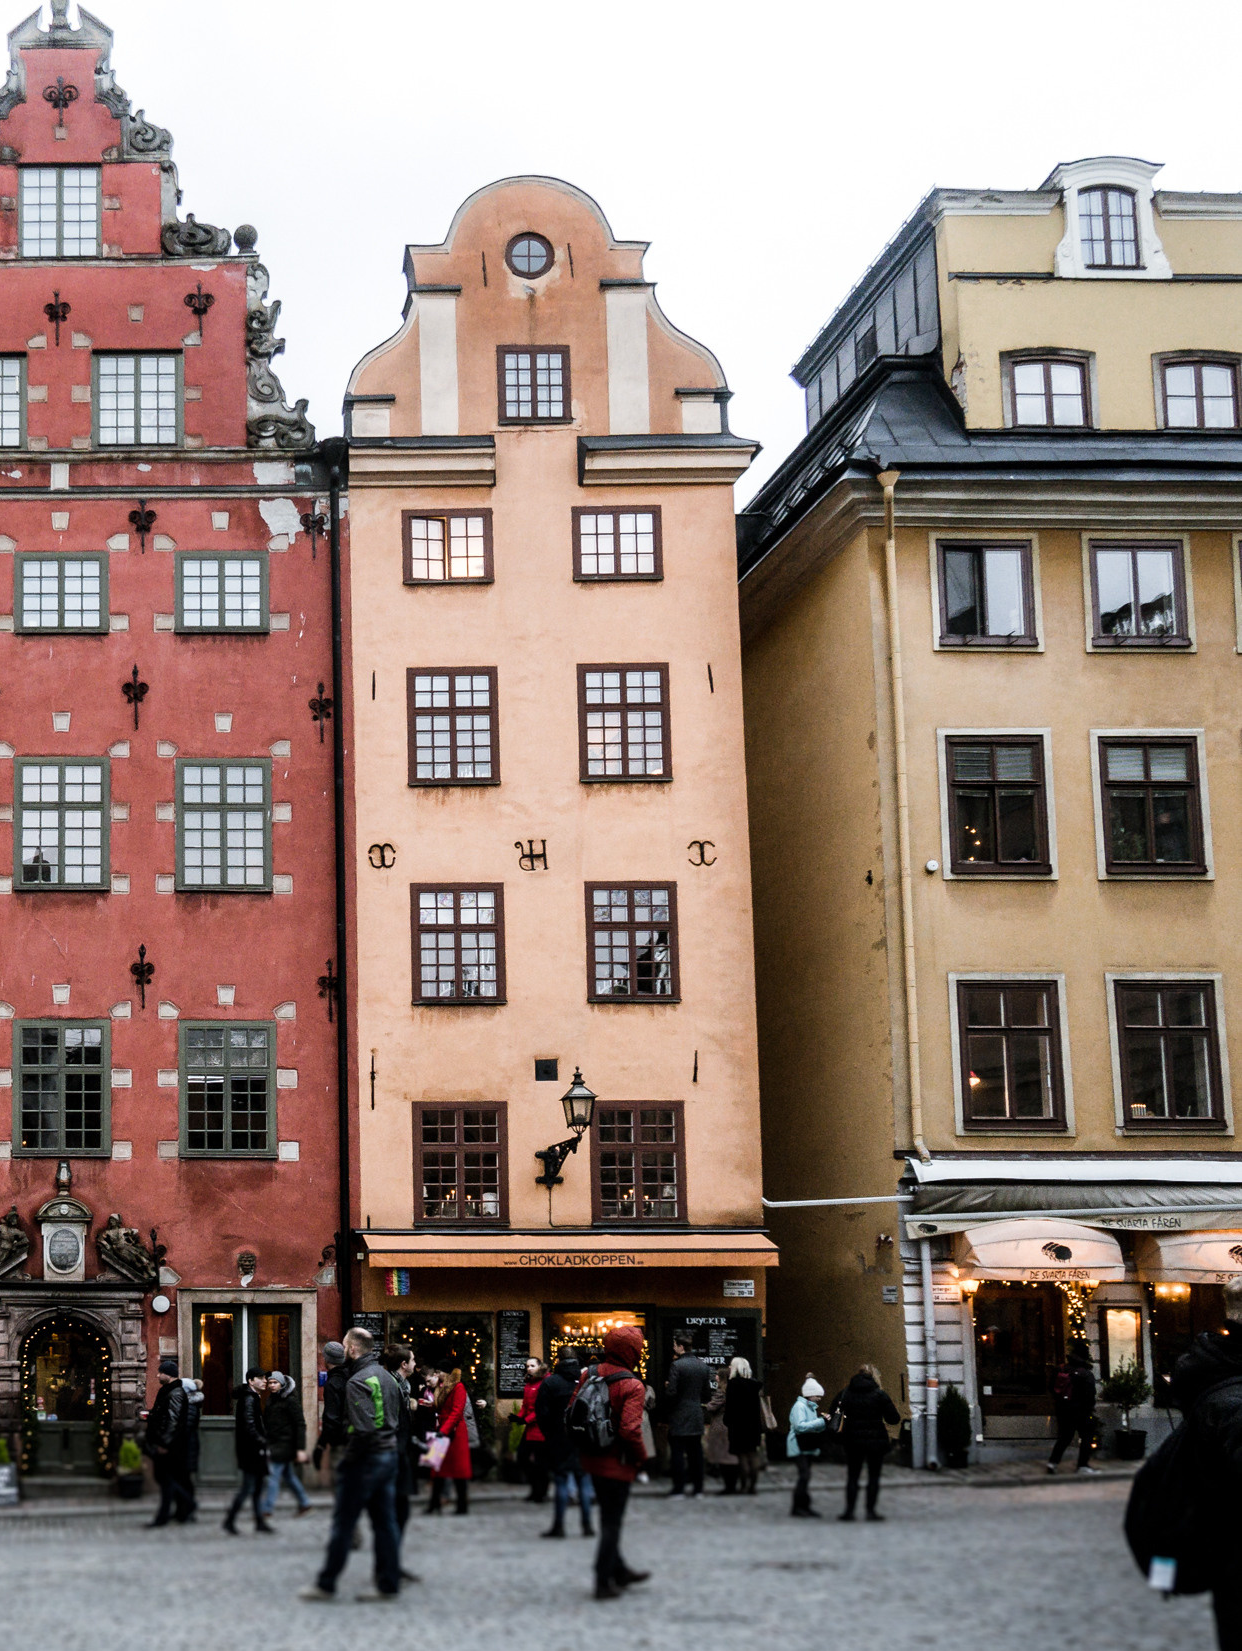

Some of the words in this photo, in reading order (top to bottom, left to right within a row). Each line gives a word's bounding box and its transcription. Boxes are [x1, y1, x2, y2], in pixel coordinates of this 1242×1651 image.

[1116, 1218, 1149, 1228] SVARTA
[1151, 1216, 1182, 1228] FÅREN
[1029, 1270, 1040, 1280] DE
[1042, 1270, 1067, 1280] SVARTA
[1068, 1268, 1091, 1280] FÅREN
[1215, 1273, 1227, 1283] DE
